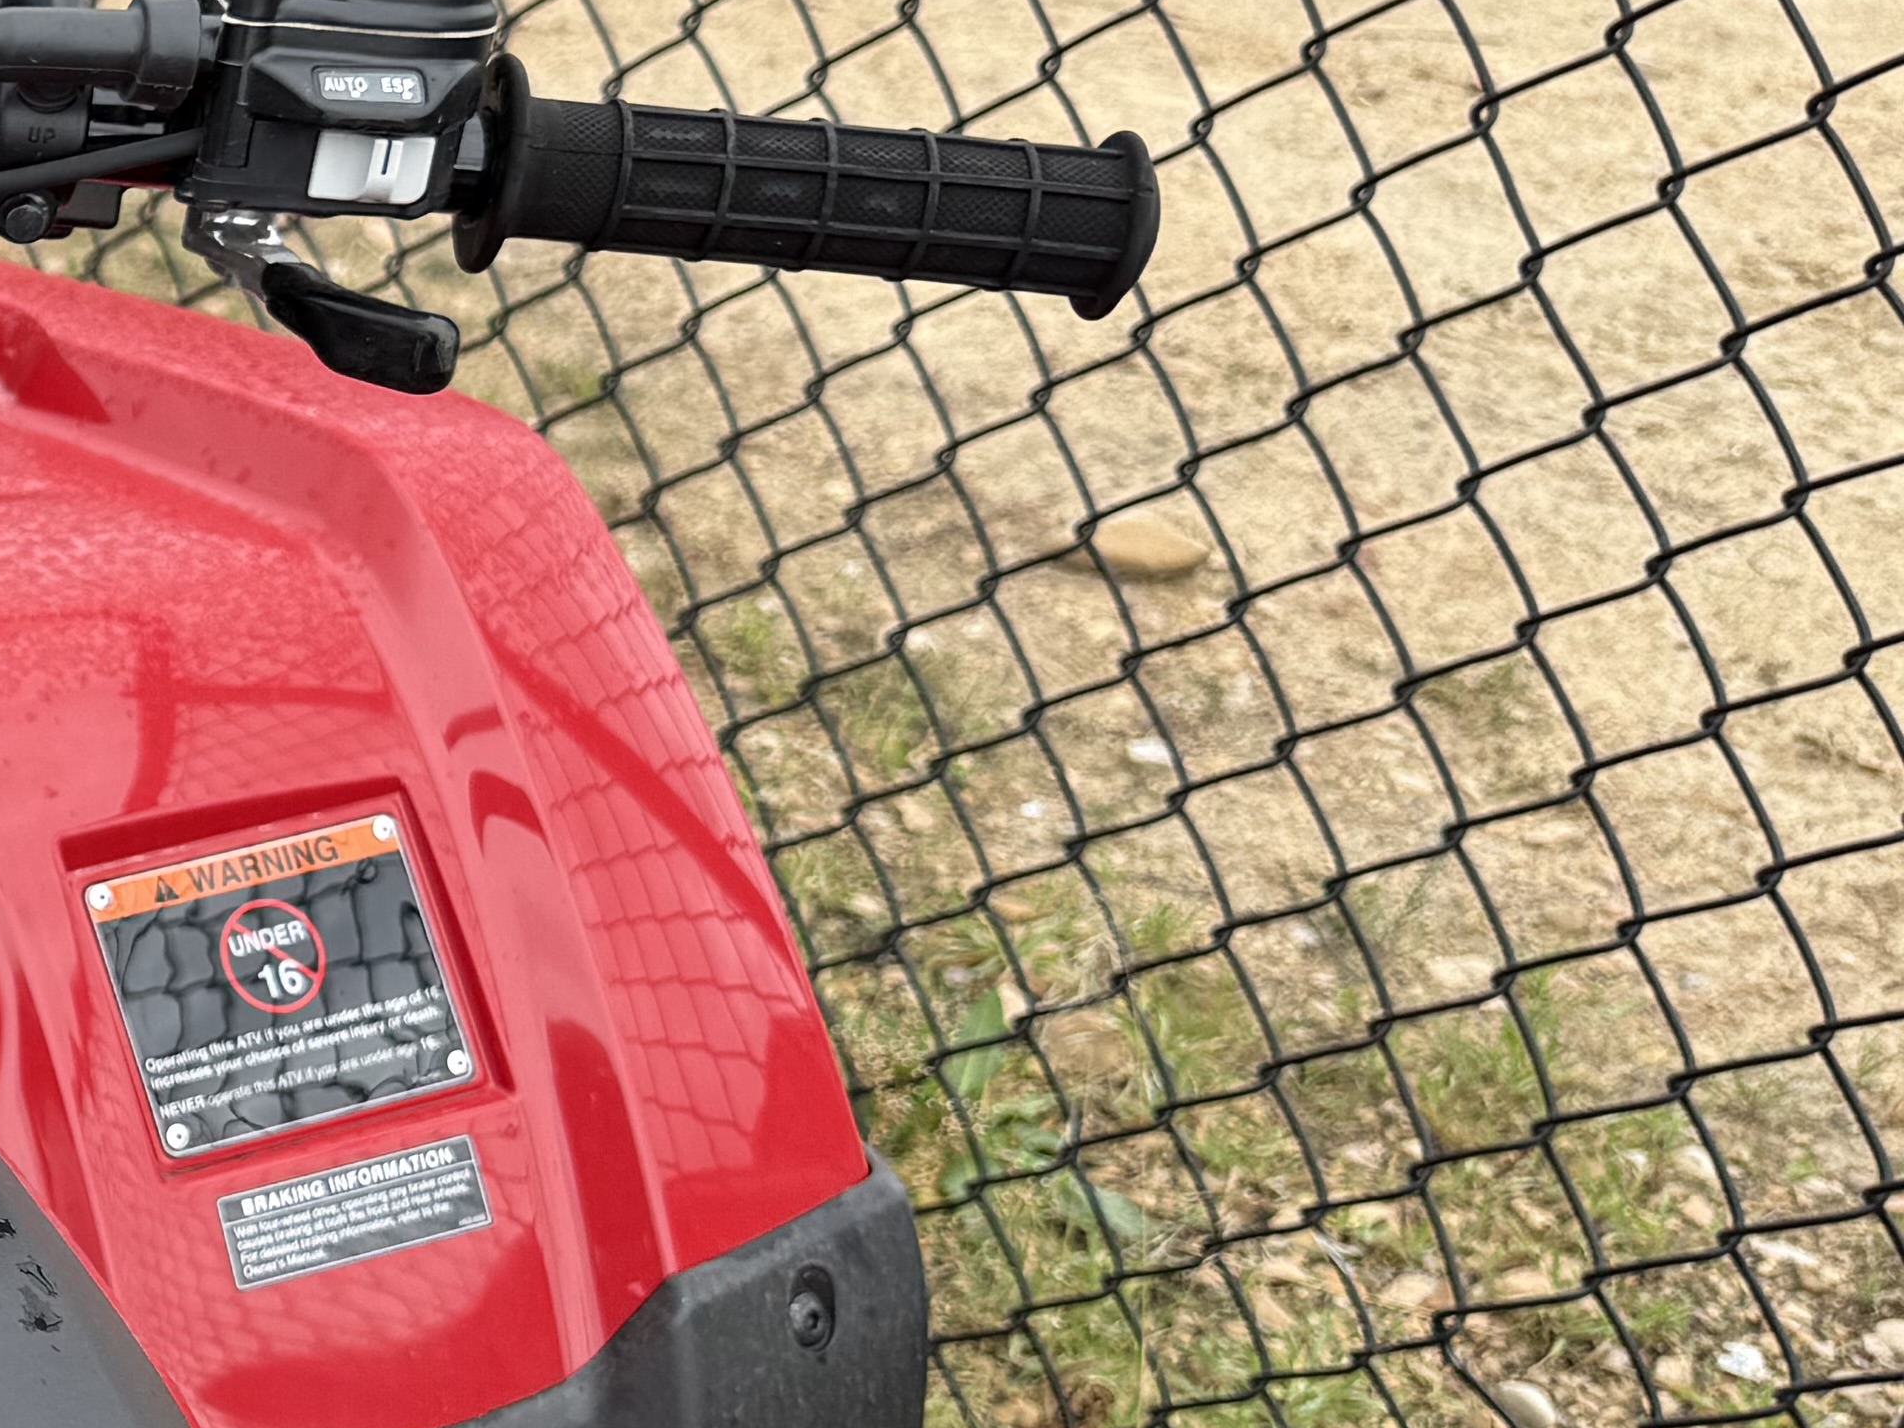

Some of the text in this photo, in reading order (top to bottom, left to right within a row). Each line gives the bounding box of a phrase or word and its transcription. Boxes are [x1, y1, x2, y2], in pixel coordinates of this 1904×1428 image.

[324, 76, 415, 93] AUTO ESP
[28, 126, 56, 145] UP
[189, 837, 339, 894] WARNING
[228, 920, 305, 957] UNDER
[257, 958, 306, 998] 16
[144, 1046, 210, 1074] Operating
[208, 1040, 236, 1056] this
[236, 1030, 263, 1050] ATV
[274, 1023, 301, 1042] you
[361, 1002, 384, 1018] the
[149, 1064, 214, 1090] increases
[213, 1056, 245, 1077] your
[244, 1044, 291, 1066] chance
[348, 1020, 386, 1039] injury
[387, 1015, 402, 1030] or
[158, 1094, 206, 1124] NEVER
[277, 1069, 303, 1090] ATV
[241, 1183, 327, 1216] BRAKING
[328, 1148, 455, 1194] INFORMATION
